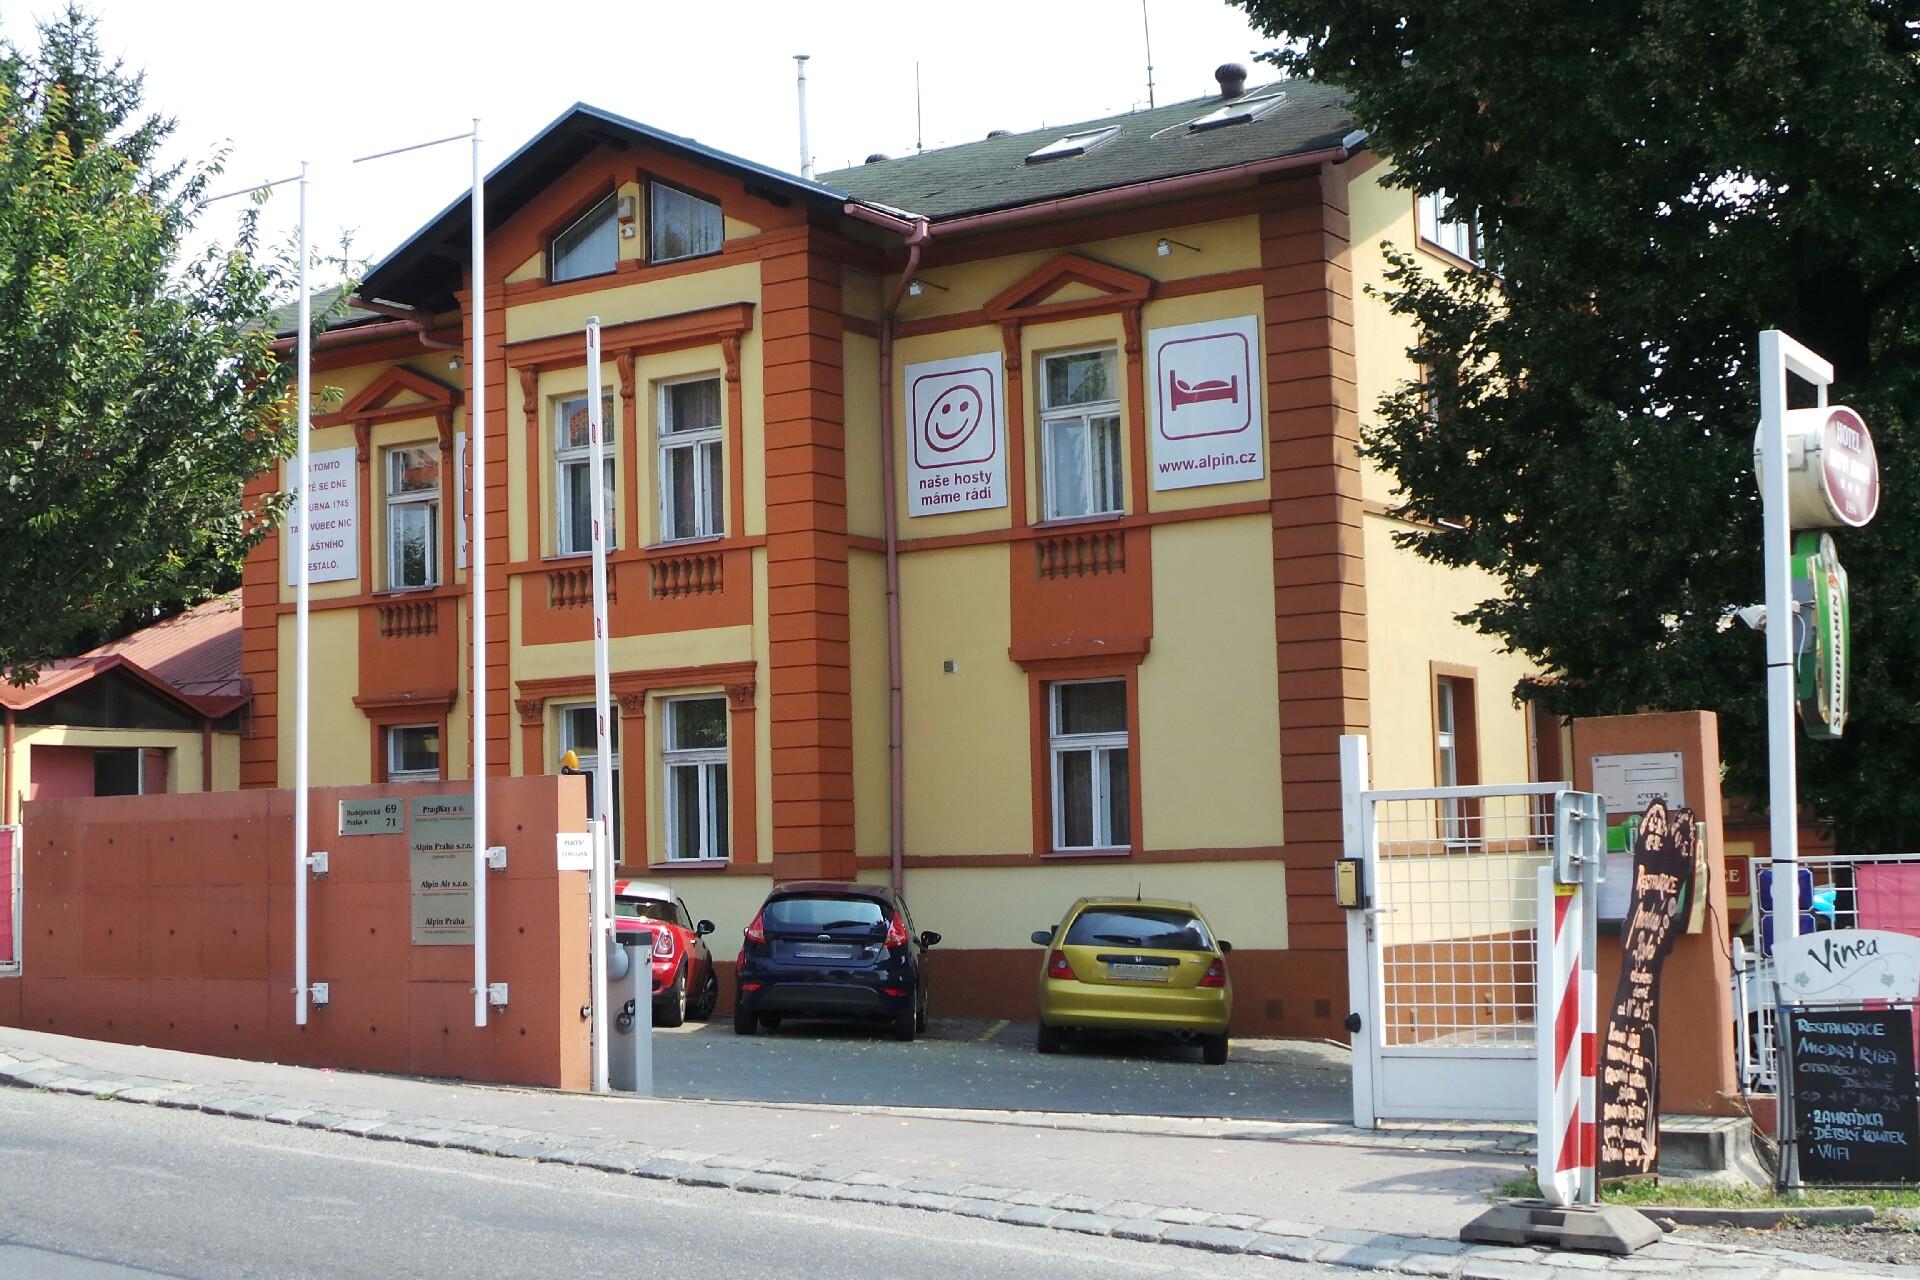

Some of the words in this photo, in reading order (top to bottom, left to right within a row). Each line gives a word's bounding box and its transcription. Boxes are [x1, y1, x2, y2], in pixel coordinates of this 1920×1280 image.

[1836, 420, 1862, 453] HOTEL
[314, 460, 340, 472] TOMTO
[1158, 451, 1257, 475] www.alpin.cz
[319, 480, 329, 491] SE
[331, 479, 347, 489] DNE
[919, 473, 950, 490] naše
[954, 470, 993, 489] hosty
[921, 489, 961, 506] máme
[965, 486, 992, 502] rádi
[308, 501, 330, 512] UBNA
[333, 499, 349, 509] 1745
[310, 520, 336, 532] VŮBEC
[338, 518, 352, 528] NIC
[308, 560, 339, 572] ESTALO.
[1831, 594, 1842, 729] STAROPRAMEN
[385, 804, 397, 814] 69
[386, 818, 397, 827] 71
[415, 843, 433, 852] Alpin
[435, 842, 455, 850] Praha
[456, 842, 473, 850] s.r.o.
[421, 880, 439, 889] Alpin
[440, 880, 451, 888] Air
[425, 917, 444, 926] Alpin
[445, 917, 465, 925] Praha
[1807, 937, 1880, 974] Vinea
[1795, 1018, 1886, 1036] RESTAURACE
[1860, 1047, 1897, 1064] RYBA
[1813, 1108, 1884, 1127] ZAHRÁDKA
[1817, 1143, 1849, 1161] WIFI
